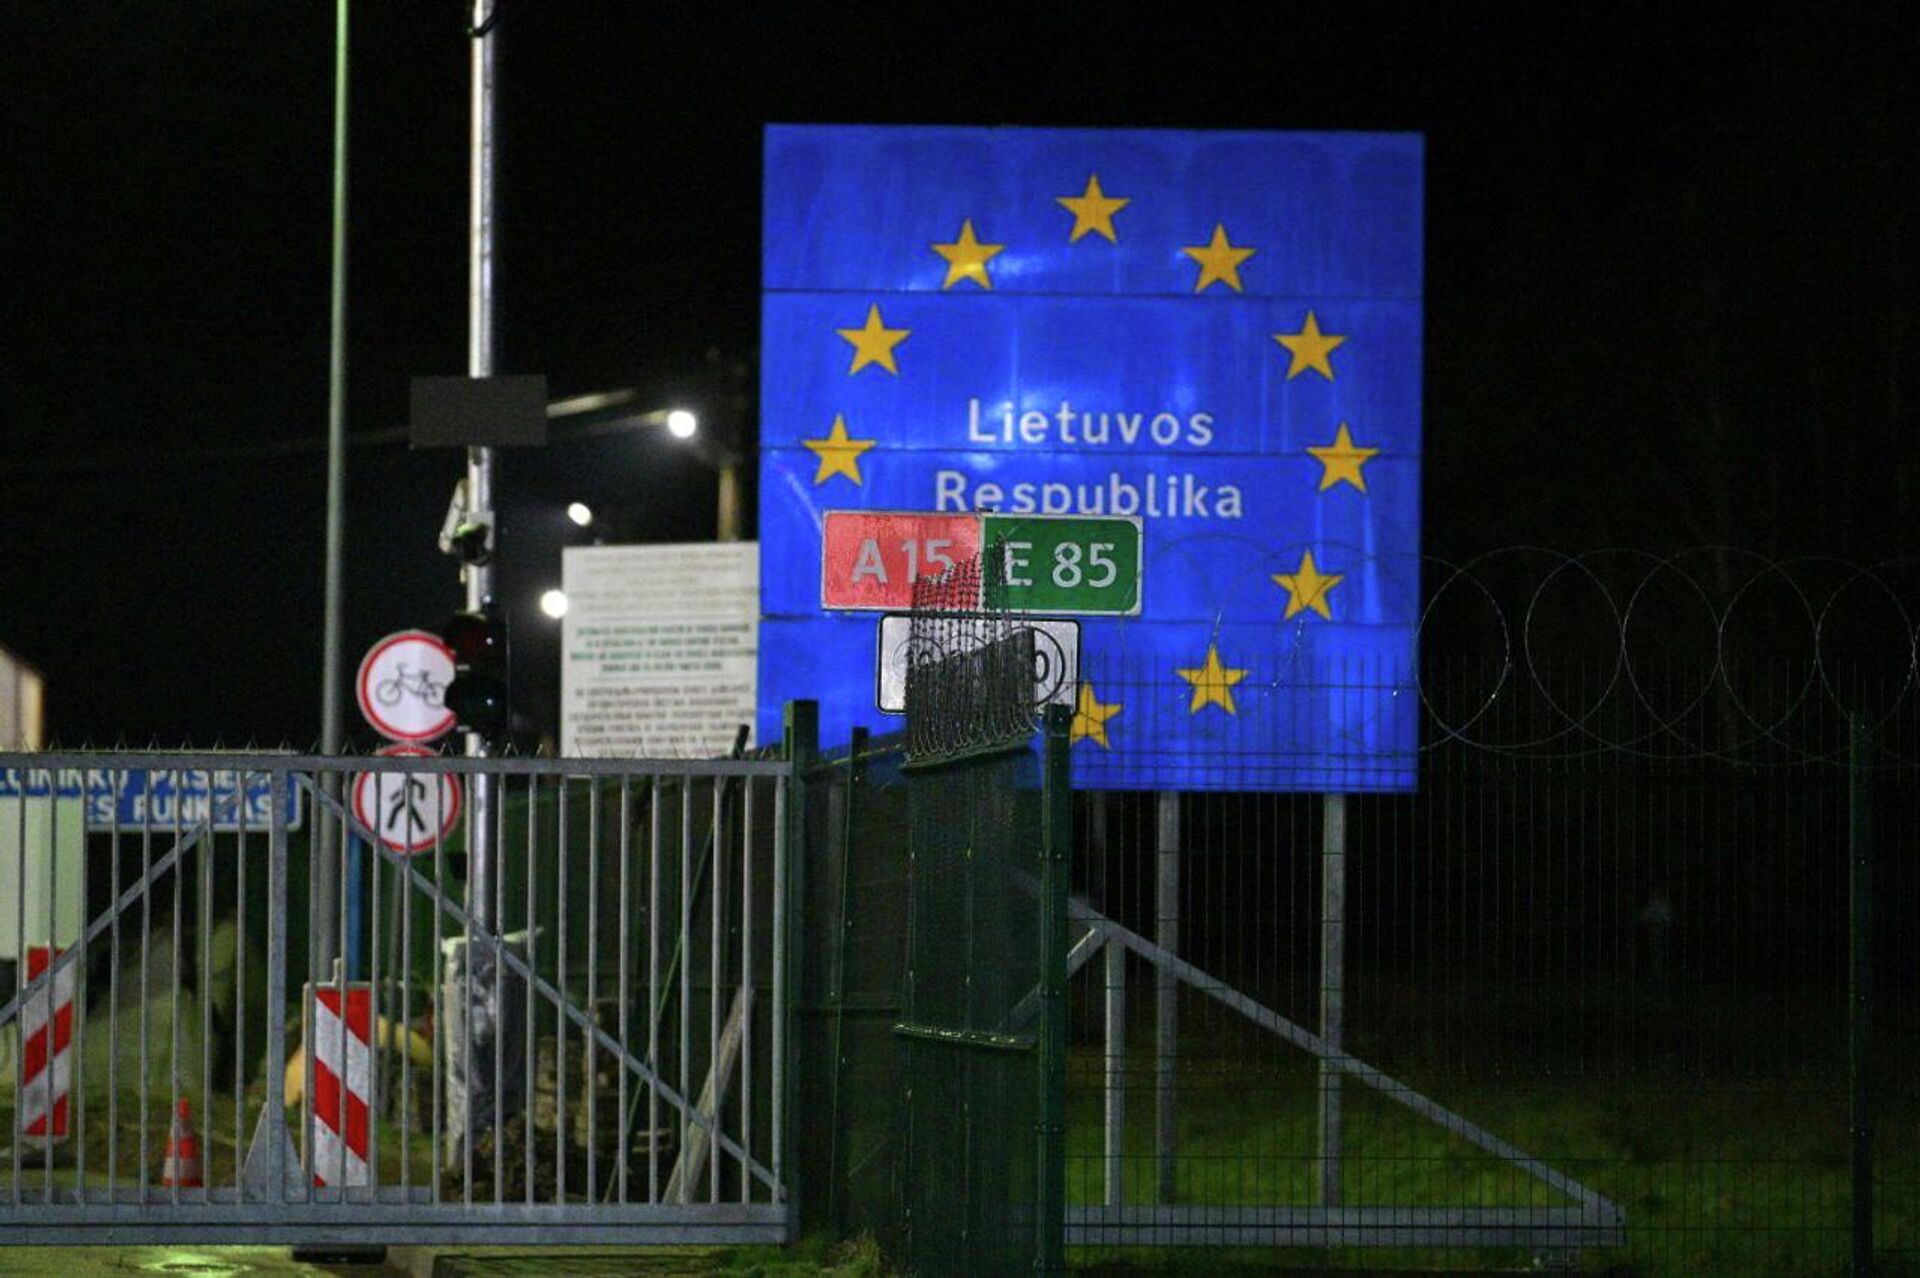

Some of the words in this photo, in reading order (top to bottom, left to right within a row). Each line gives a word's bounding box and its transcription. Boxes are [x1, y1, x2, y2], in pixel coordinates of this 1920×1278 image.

[968, 398, 1214, 445] Lietuvos
[936, 470, 1243, 518] Respublika
[851, 538, 889, 584] A
[901, 540, 954, 584] 15
[1005, 541, 1034, 587] E
[1052, 542, 1118, 588] 85
